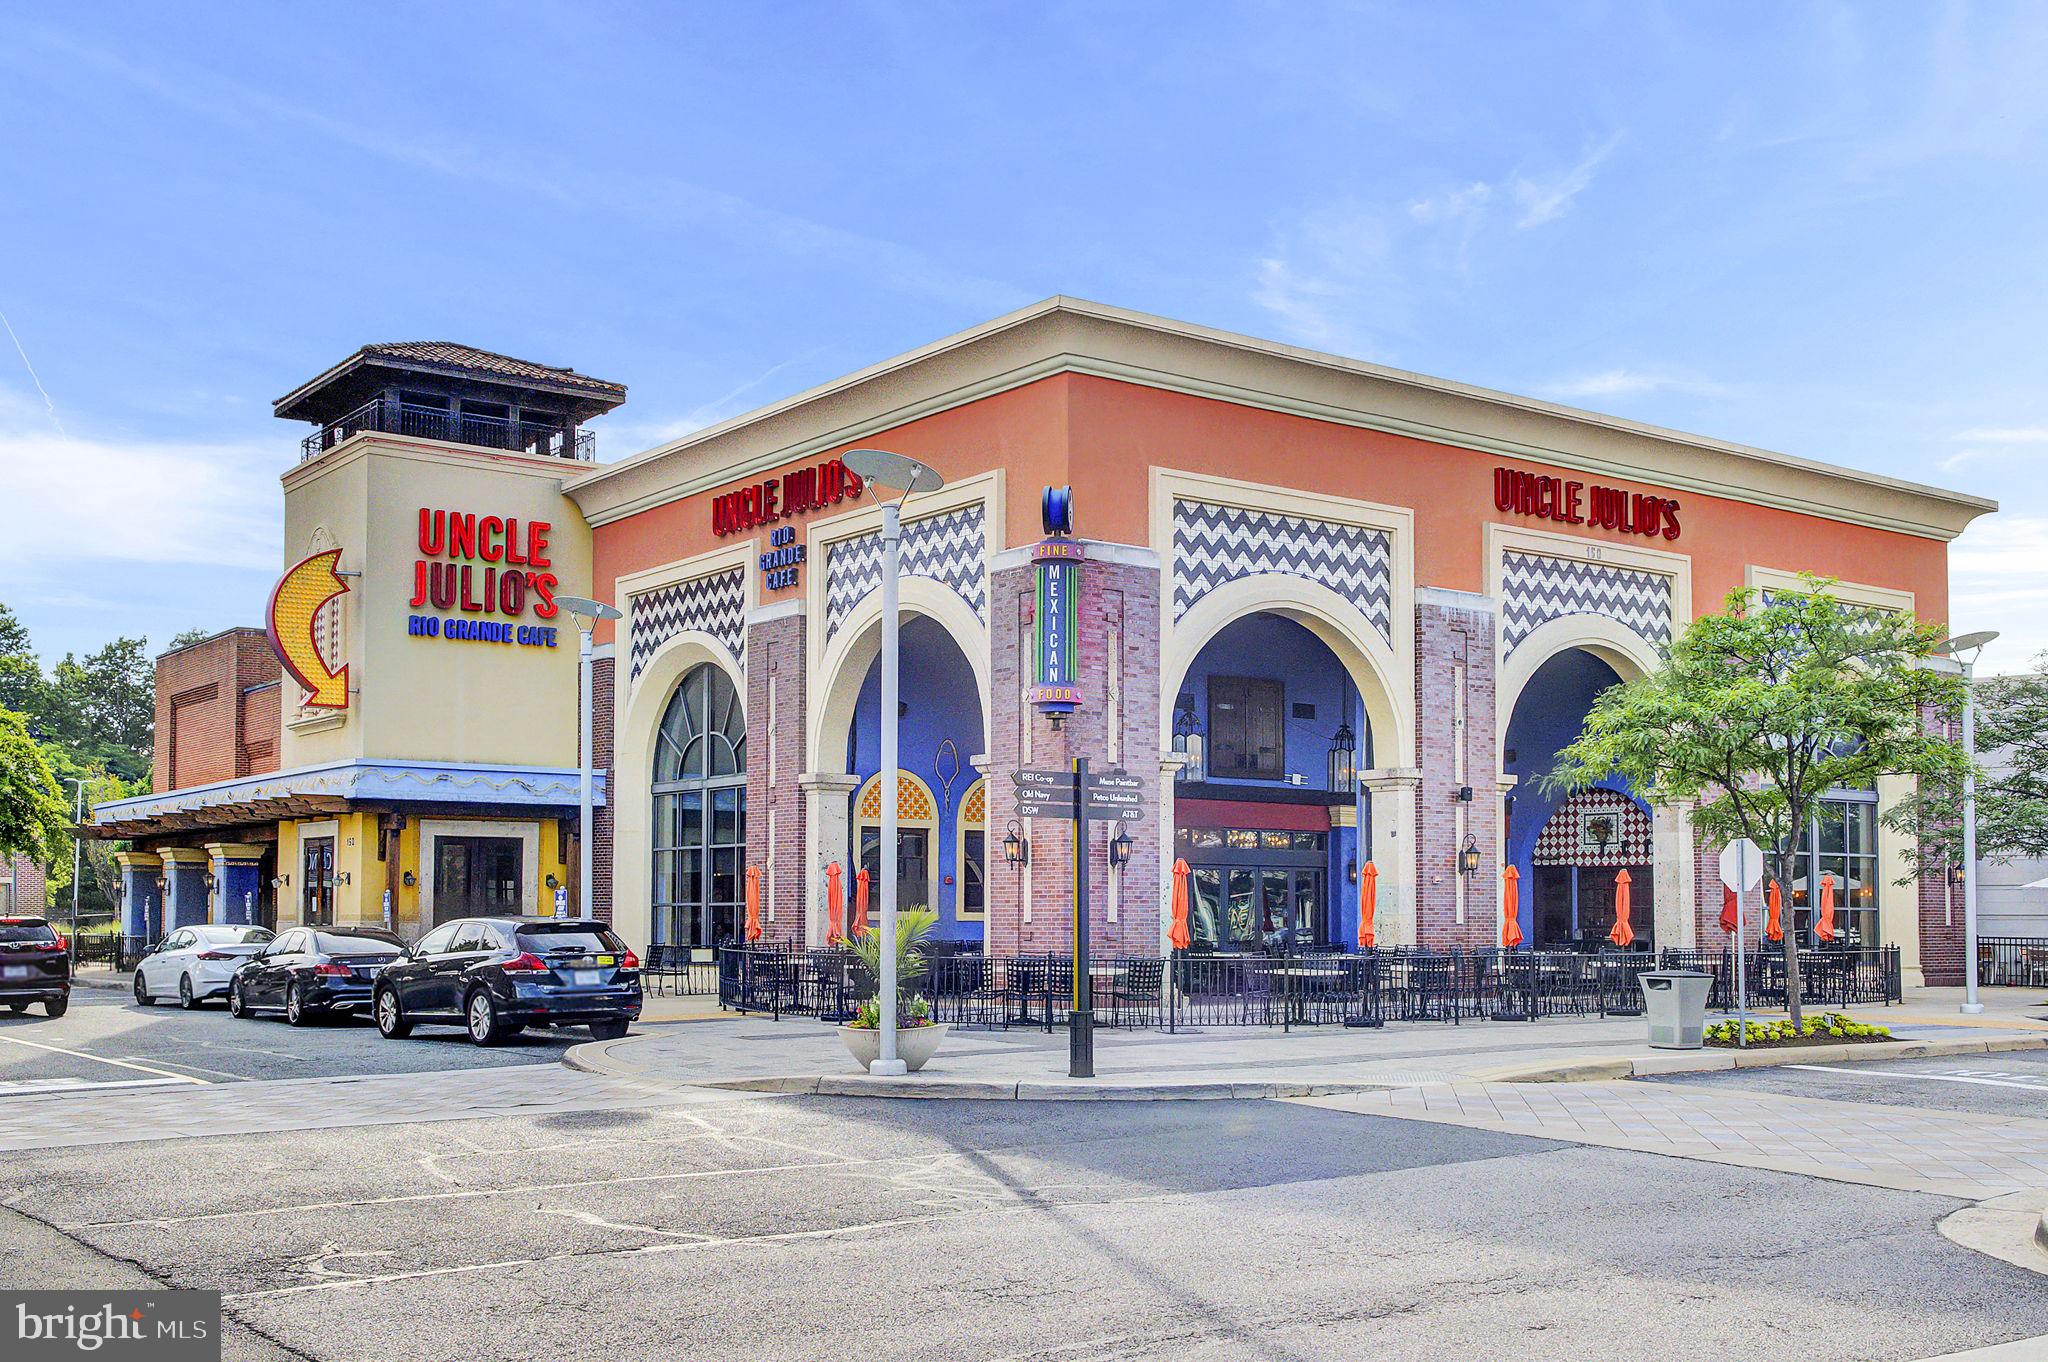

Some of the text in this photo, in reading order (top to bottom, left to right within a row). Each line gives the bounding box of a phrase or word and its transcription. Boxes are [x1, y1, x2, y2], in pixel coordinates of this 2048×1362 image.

[712, 478, 780, 537] UNCLE
[1494, 467, 1681, 541] UNCLE JULIO'S
[418, 507, 551, 568] UNCLE
[770, 526, 796, 547] RIO
[759, 544, 807, 572] GRANDE
[1039, 546, 1068, 557] FINE
[409, 560, 559, 619] JULIO'S
[765, 567, 799, 591] CAFE
[408, 615, 558, 648] RIO GRANDE CAFE
[1049, 564, 1060, 683] MEXICAN
[1037, 688, 1071, 700] FOOD
[1022, 773, 1054, 785] REI Co-op
[1022, 790, 1050, 801] Old Navy
[1022, 806, 1039, 815] DSW
[1121, 810, 1139, 819] AT&T
